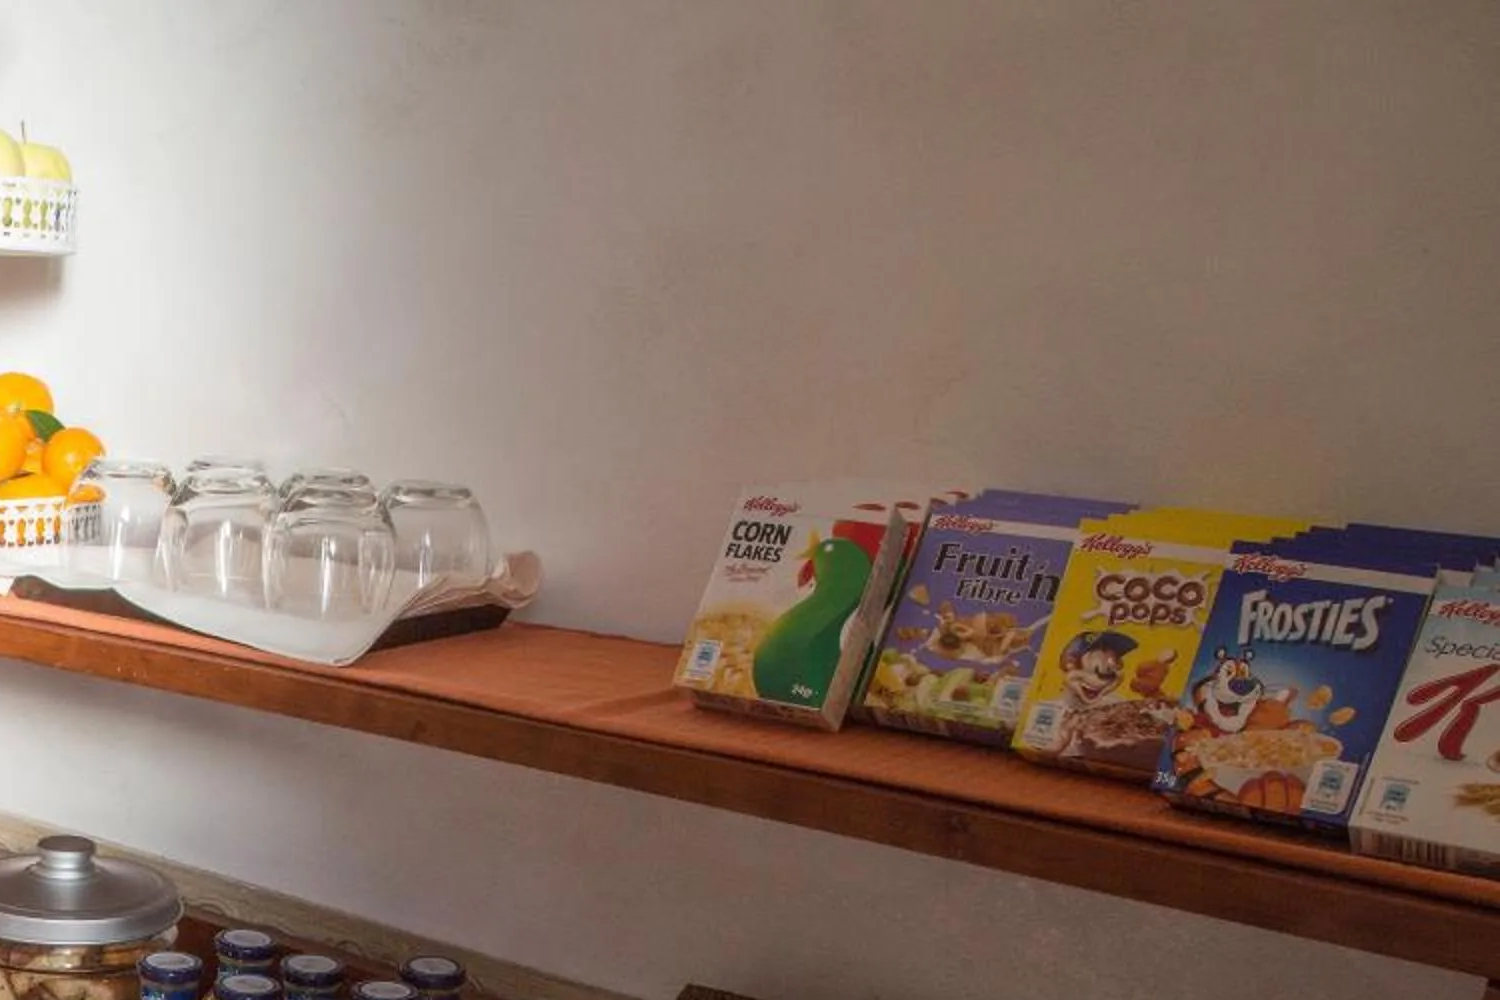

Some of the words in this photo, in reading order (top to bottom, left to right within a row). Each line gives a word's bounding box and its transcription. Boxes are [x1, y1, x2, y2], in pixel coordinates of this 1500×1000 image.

[732, 520, 793, 546] CORN
[1081, 533, 1153, 559] Kellogg's
[725, 542, 783, 563] FLAKES
[932, 542, 1031, 581] Fruit
[956, 578, 1021, 605] Fibre
[1237, 589, 1387, 651] FROSTIES
